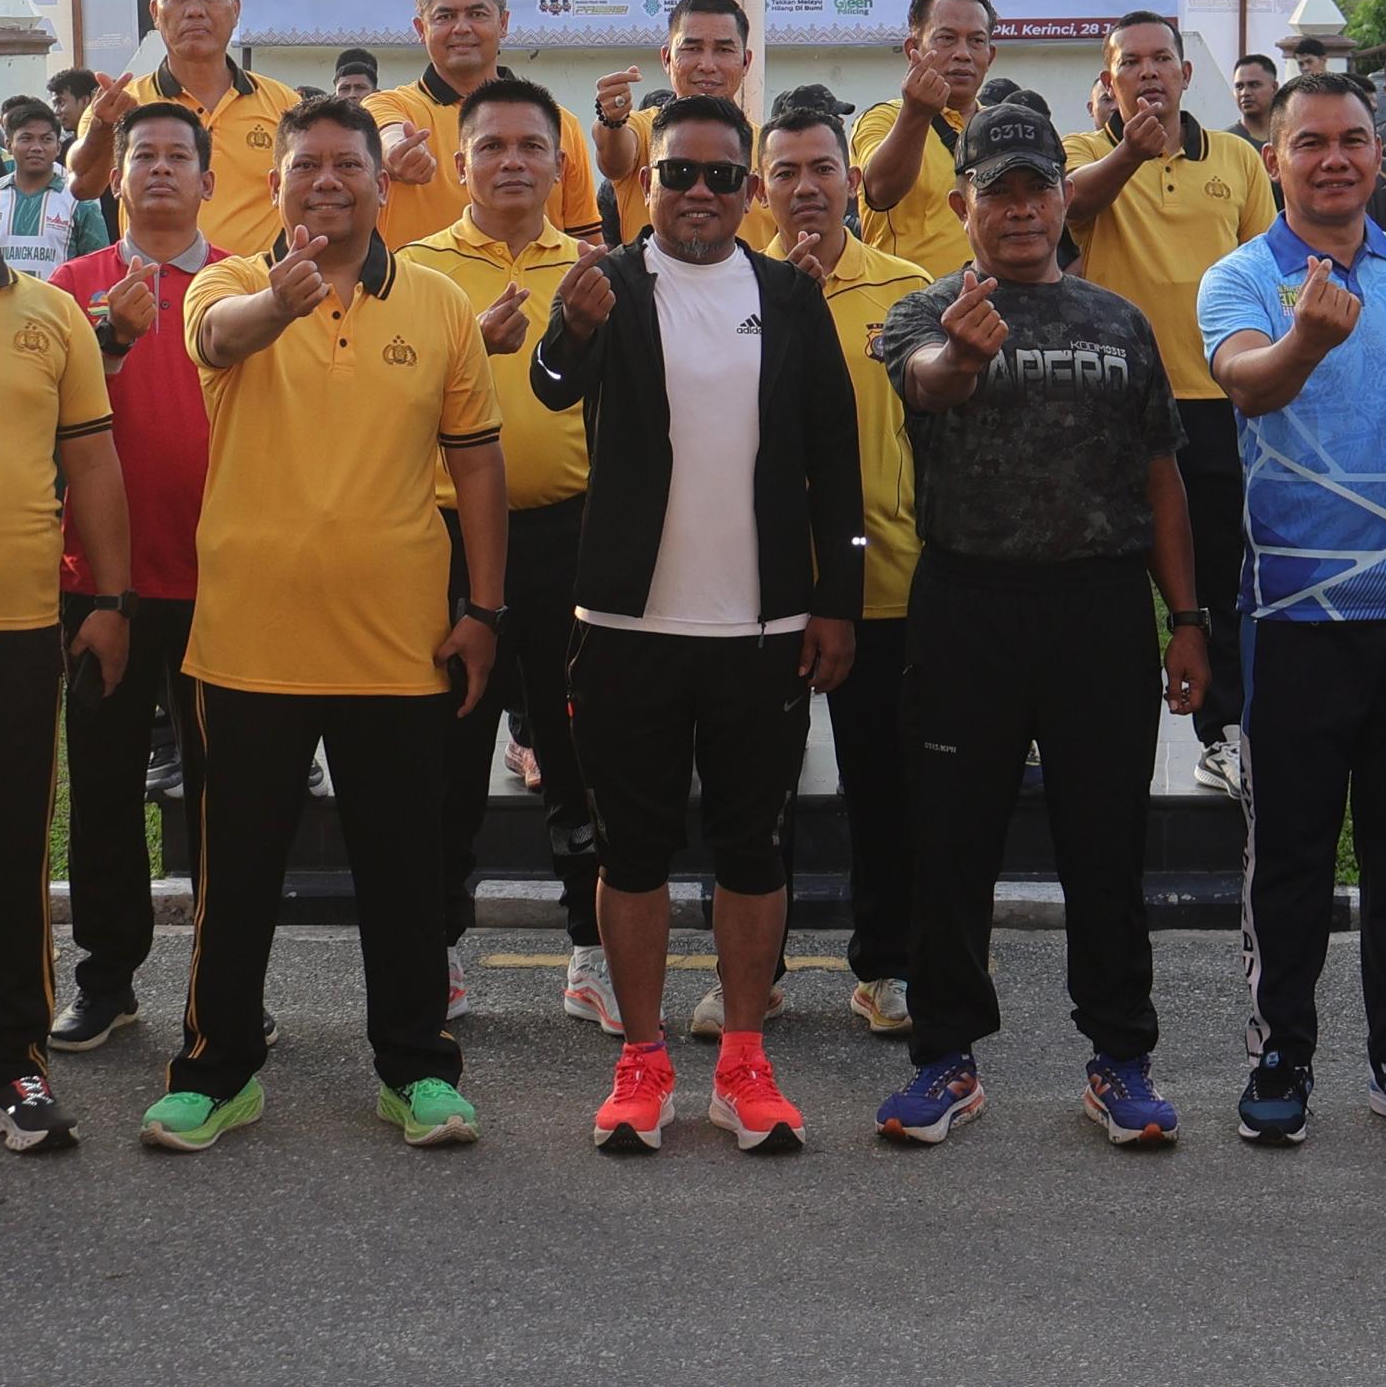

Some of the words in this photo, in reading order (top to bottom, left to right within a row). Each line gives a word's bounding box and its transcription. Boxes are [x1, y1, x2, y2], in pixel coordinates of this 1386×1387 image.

[992, 23, 1019, 36] Pkl.
[1021, 22, 1077, 38] Kerinci,
[1079, 22, 1101, 35] 28
[990, 123, 1035, 142] 0313
